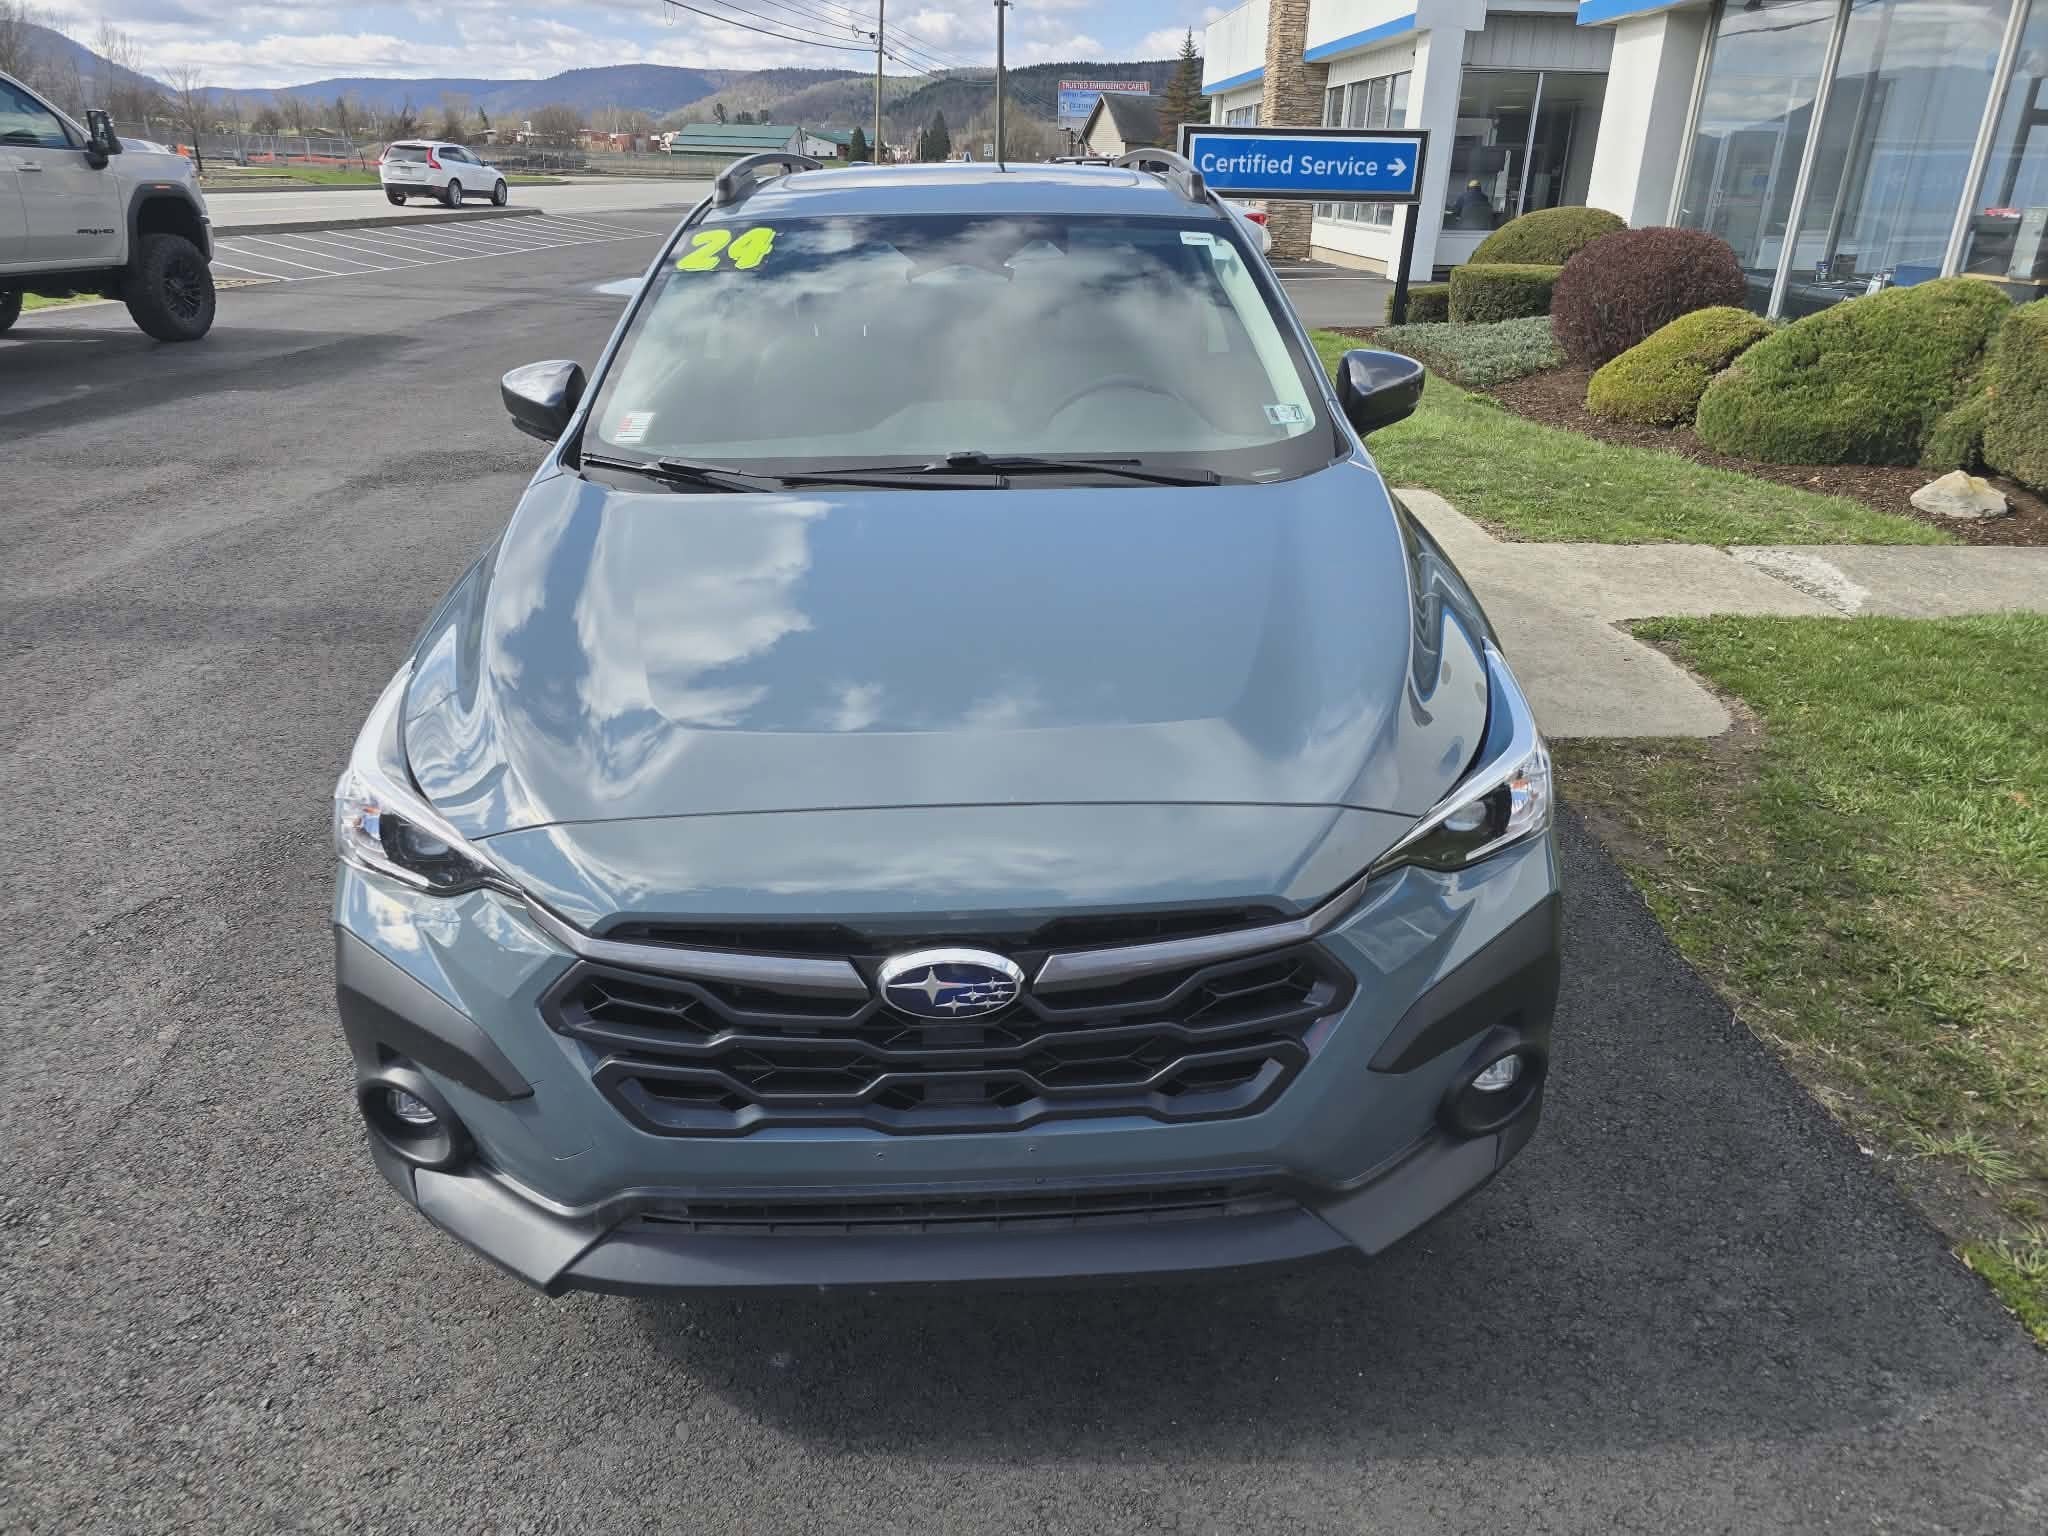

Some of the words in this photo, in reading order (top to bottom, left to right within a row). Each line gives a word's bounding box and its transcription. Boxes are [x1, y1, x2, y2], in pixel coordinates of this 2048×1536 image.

[1089, 82, 1126, 90] EMERGENCY
[1201, 153, 1292, 174] Certified
[1300, 155, 1378, 176] Service
[676, 227, 776, 272] 24
